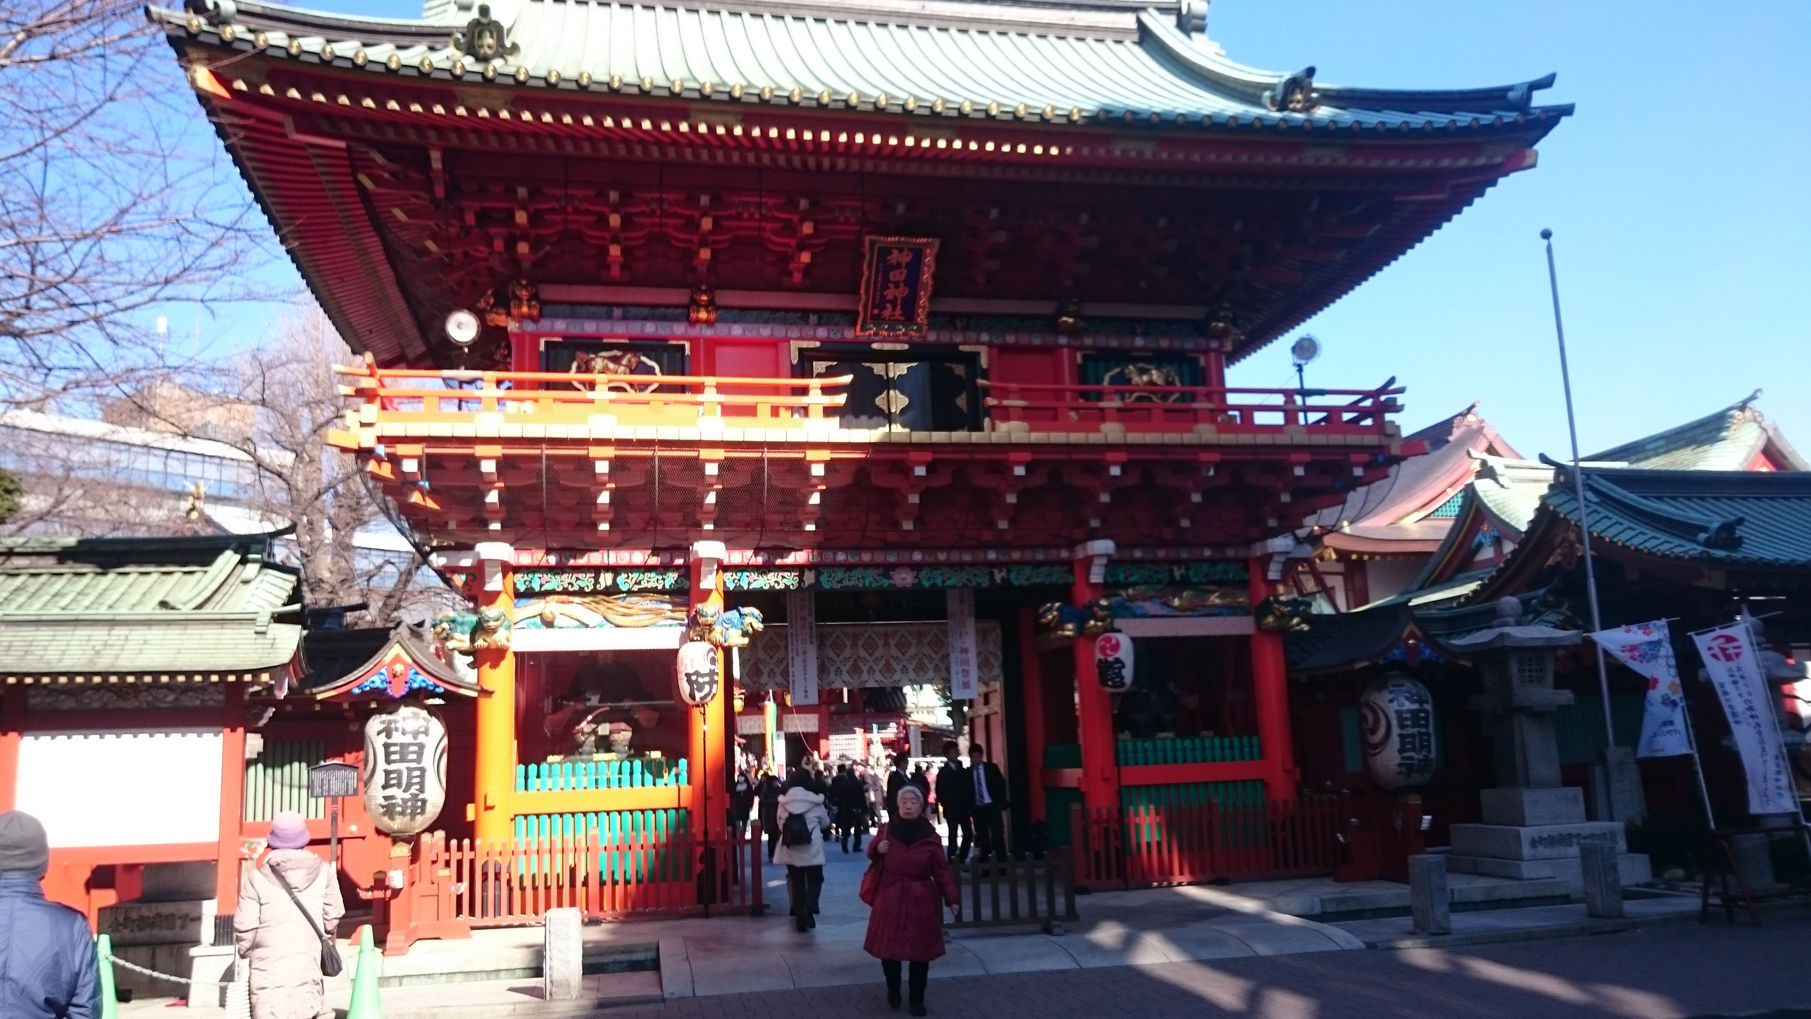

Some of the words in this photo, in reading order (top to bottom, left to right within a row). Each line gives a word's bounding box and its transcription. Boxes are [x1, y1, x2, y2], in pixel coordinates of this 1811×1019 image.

[881, 247, 913, 320] 神田神社
[376, 712, 430, 821] 神田明神
[1388, 684, 1433, 777] 神田明神
